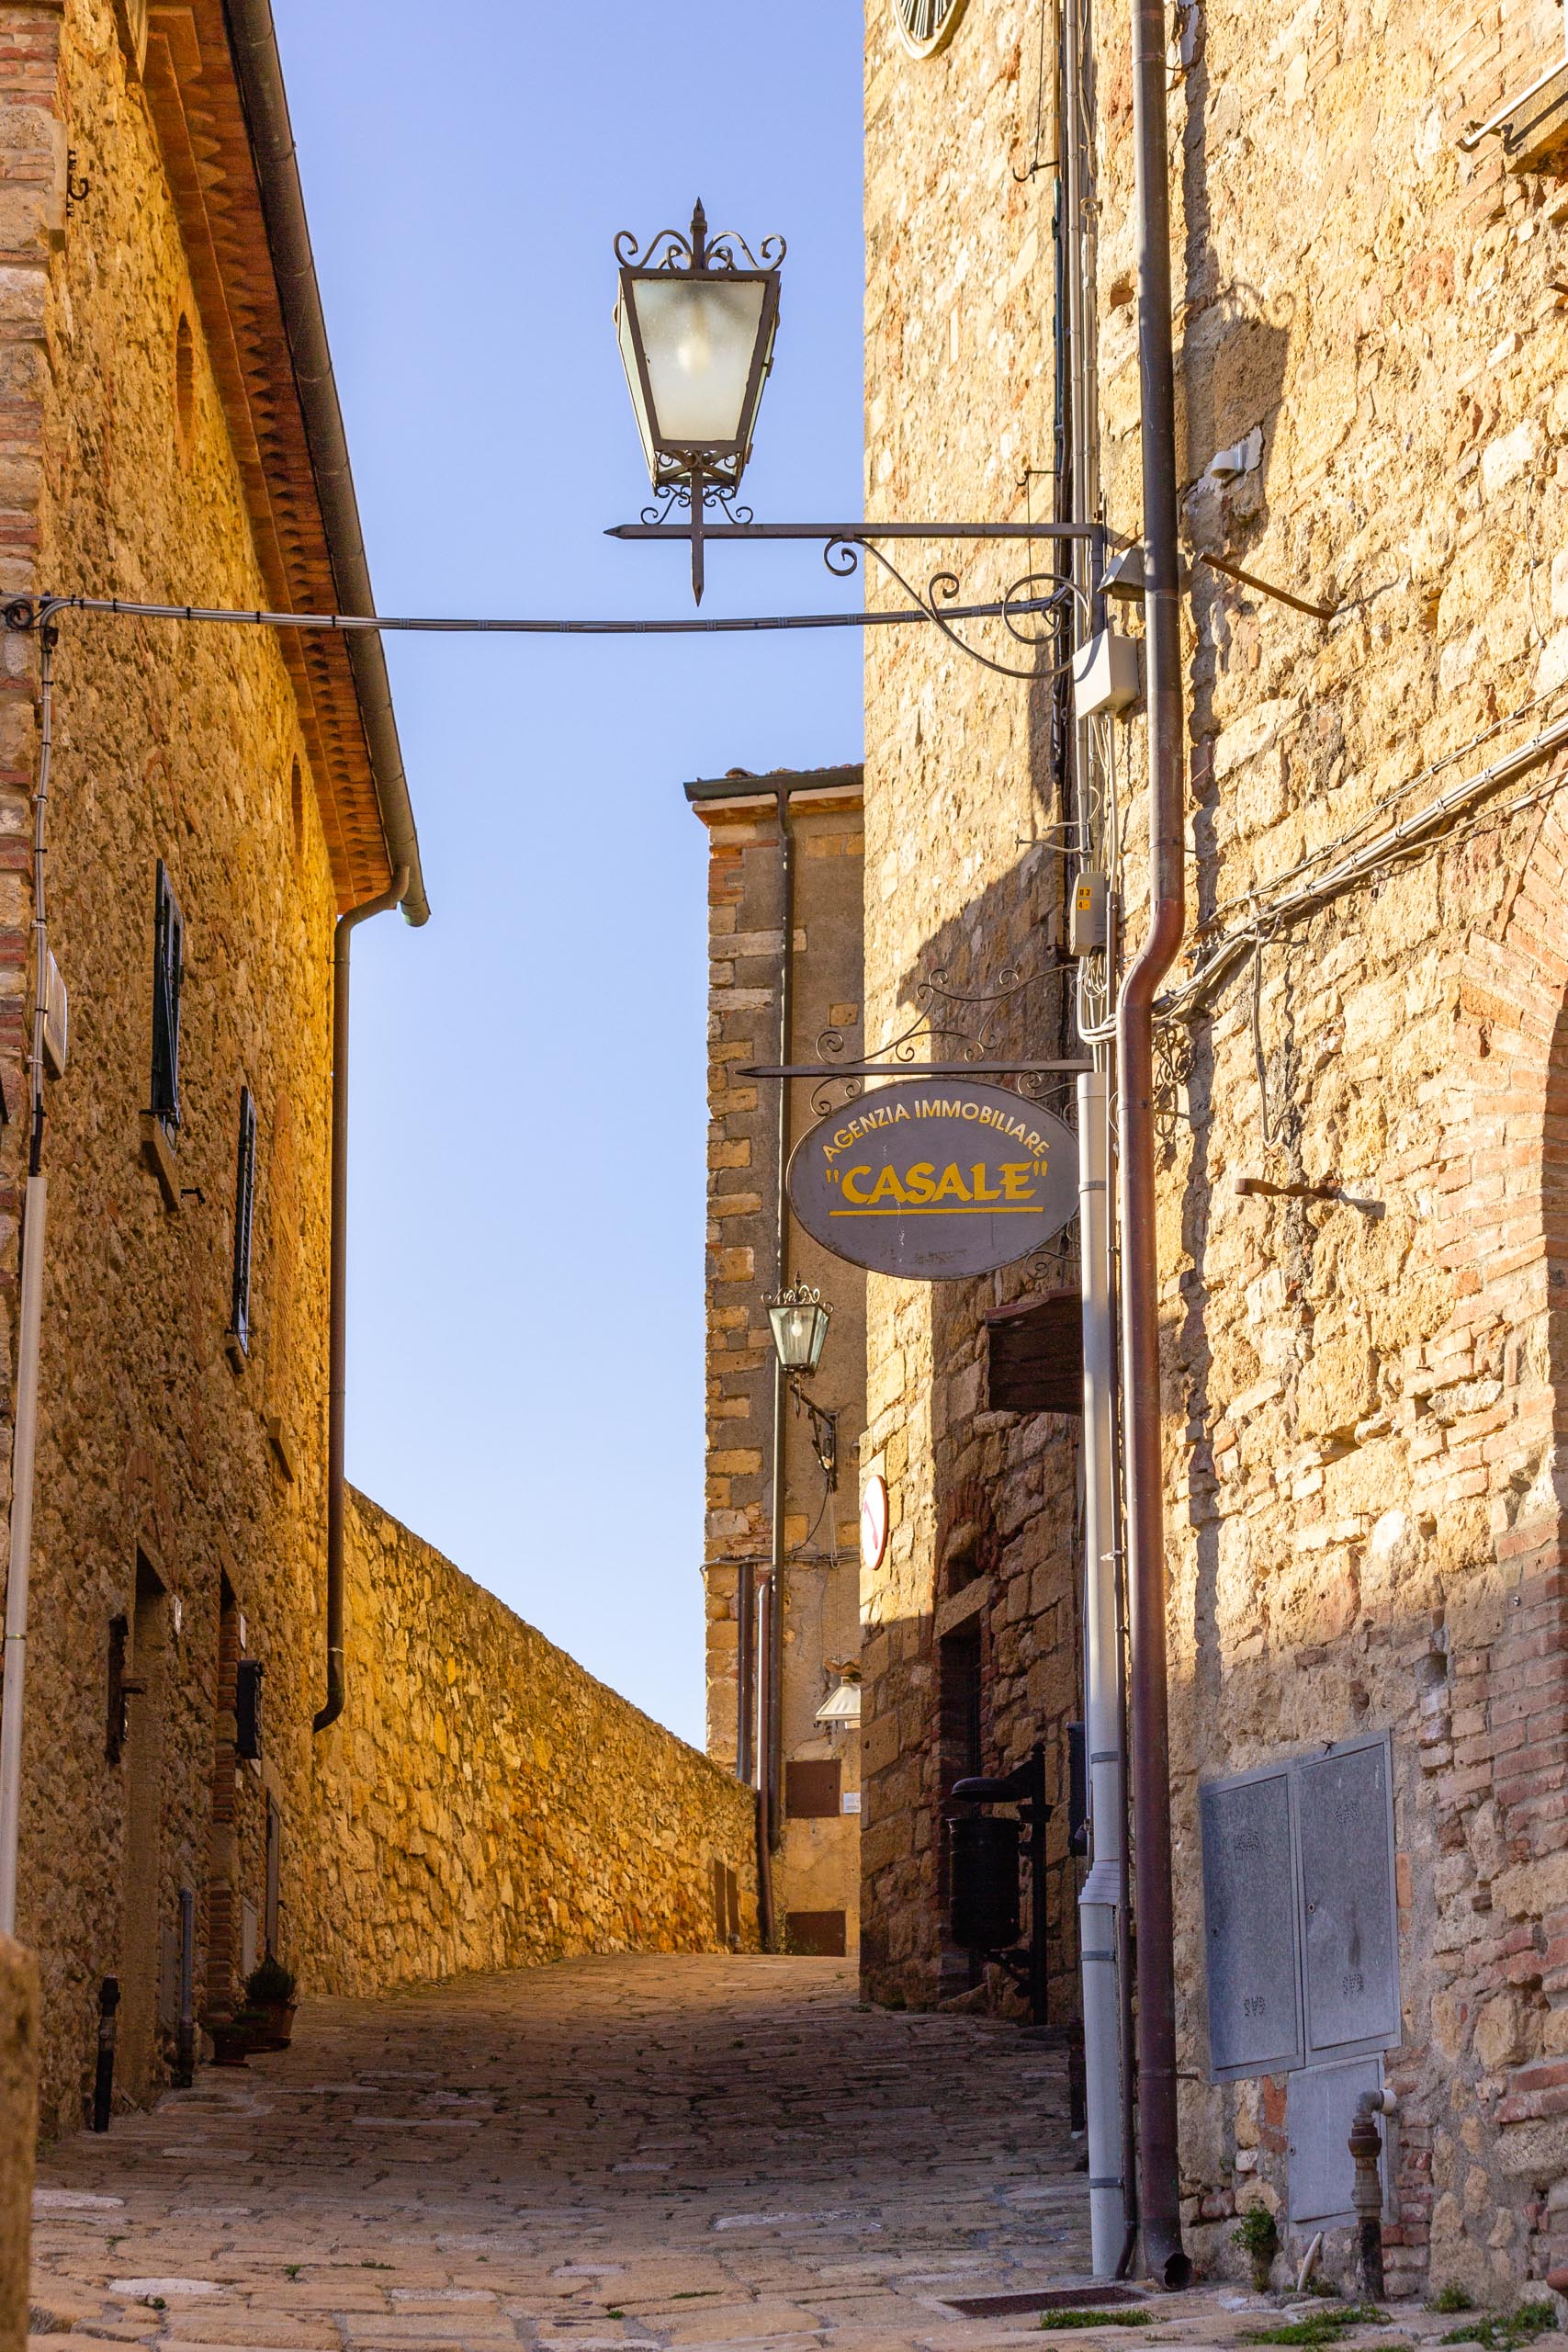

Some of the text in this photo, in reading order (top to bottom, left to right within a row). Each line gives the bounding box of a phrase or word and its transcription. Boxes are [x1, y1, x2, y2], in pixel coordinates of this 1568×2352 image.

[822, 1100, 1050, 1162] AGENZIA IMMOBILIARE
[826, 1160, 1048, 1205] "CASALE"
